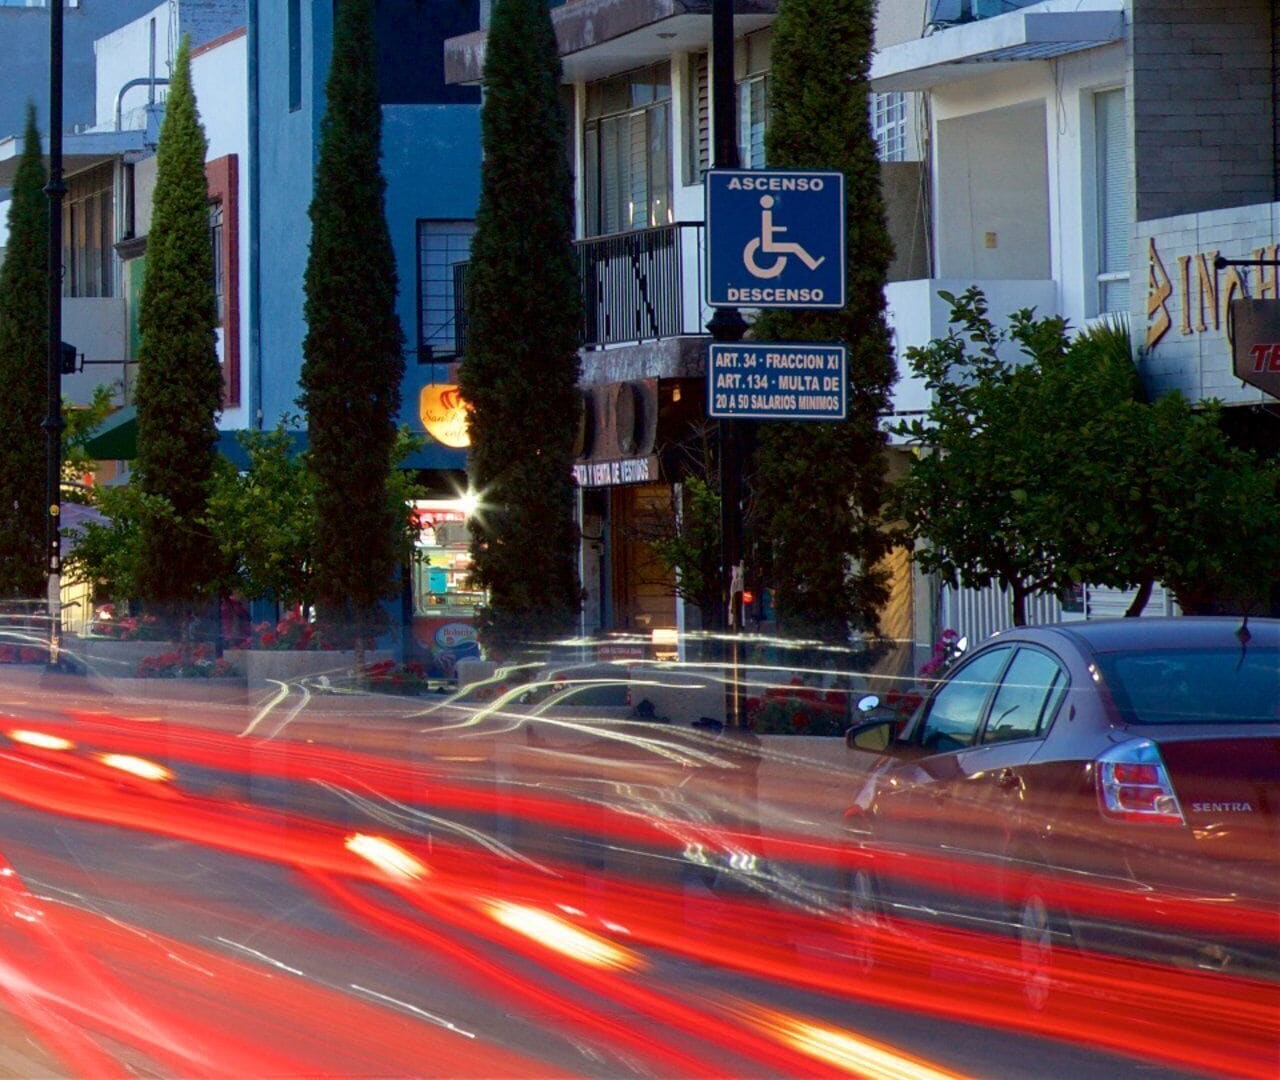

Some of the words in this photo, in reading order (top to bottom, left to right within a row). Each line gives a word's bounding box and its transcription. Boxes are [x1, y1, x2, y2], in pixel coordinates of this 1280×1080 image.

[727, 177, 824, 191] ASCENSO
[727, 288, 824, 302] DESCENSO
[716, 352, 741, 368] ART.
[743, 353, 757, 368] 34
[766, 354, 824, 369] FRACCION
[827, 355, 839, 370] XI
[778, 376, 820, 391] MULTA
[823, 377, 839, 391] DE
[716, 394, 727, 409] 20
[729, 394, 736, 408] A
[738, 395, 749, 409] 50
[751, 395, 797, 410] SALARIOS
[799, 396, 839, 410] MINIMOS
[1192, 802, 1252, 812] SENTRA
